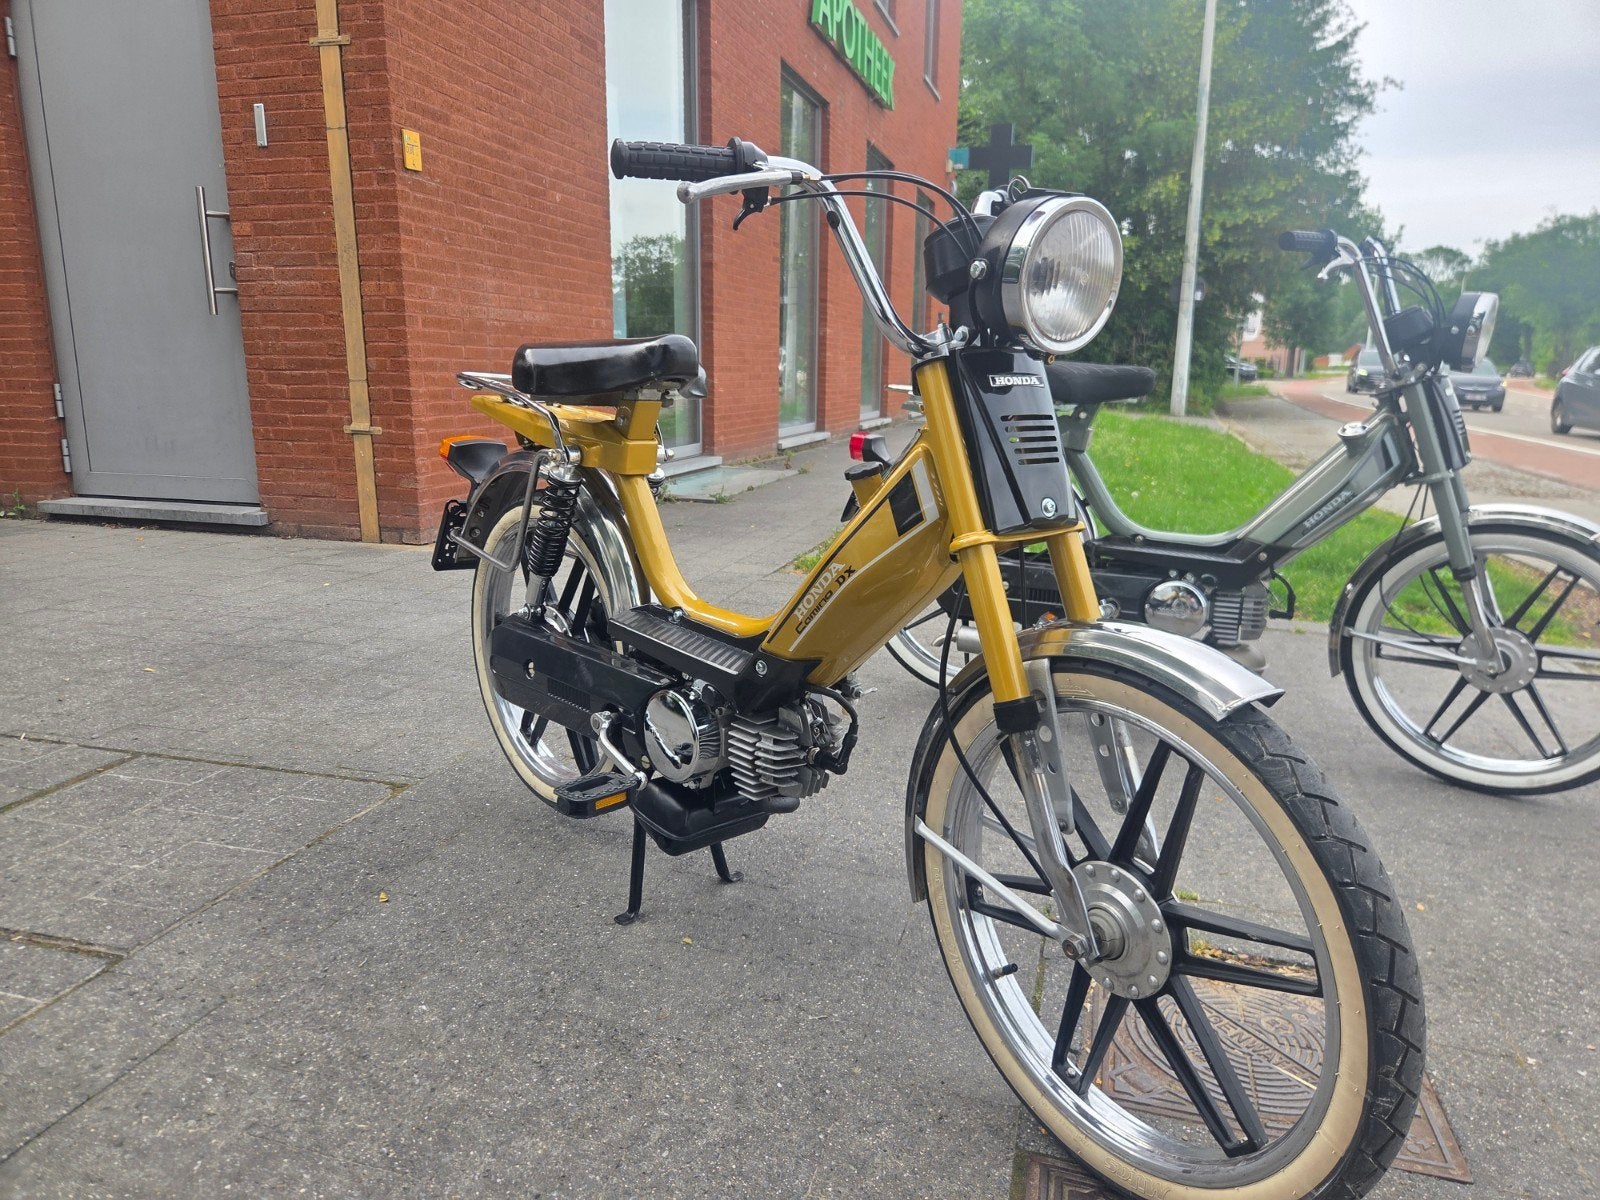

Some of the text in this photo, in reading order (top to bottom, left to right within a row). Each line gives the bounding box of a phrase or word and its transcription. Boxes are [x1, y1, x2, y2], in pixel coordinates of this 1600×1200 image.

[995, 376, 1041, 387] HONDA
[1303, 490, 1353, 528] HONDA
[793, 562, 845, 621] HONDA
[795, 565, 856, 635] Camino DX
